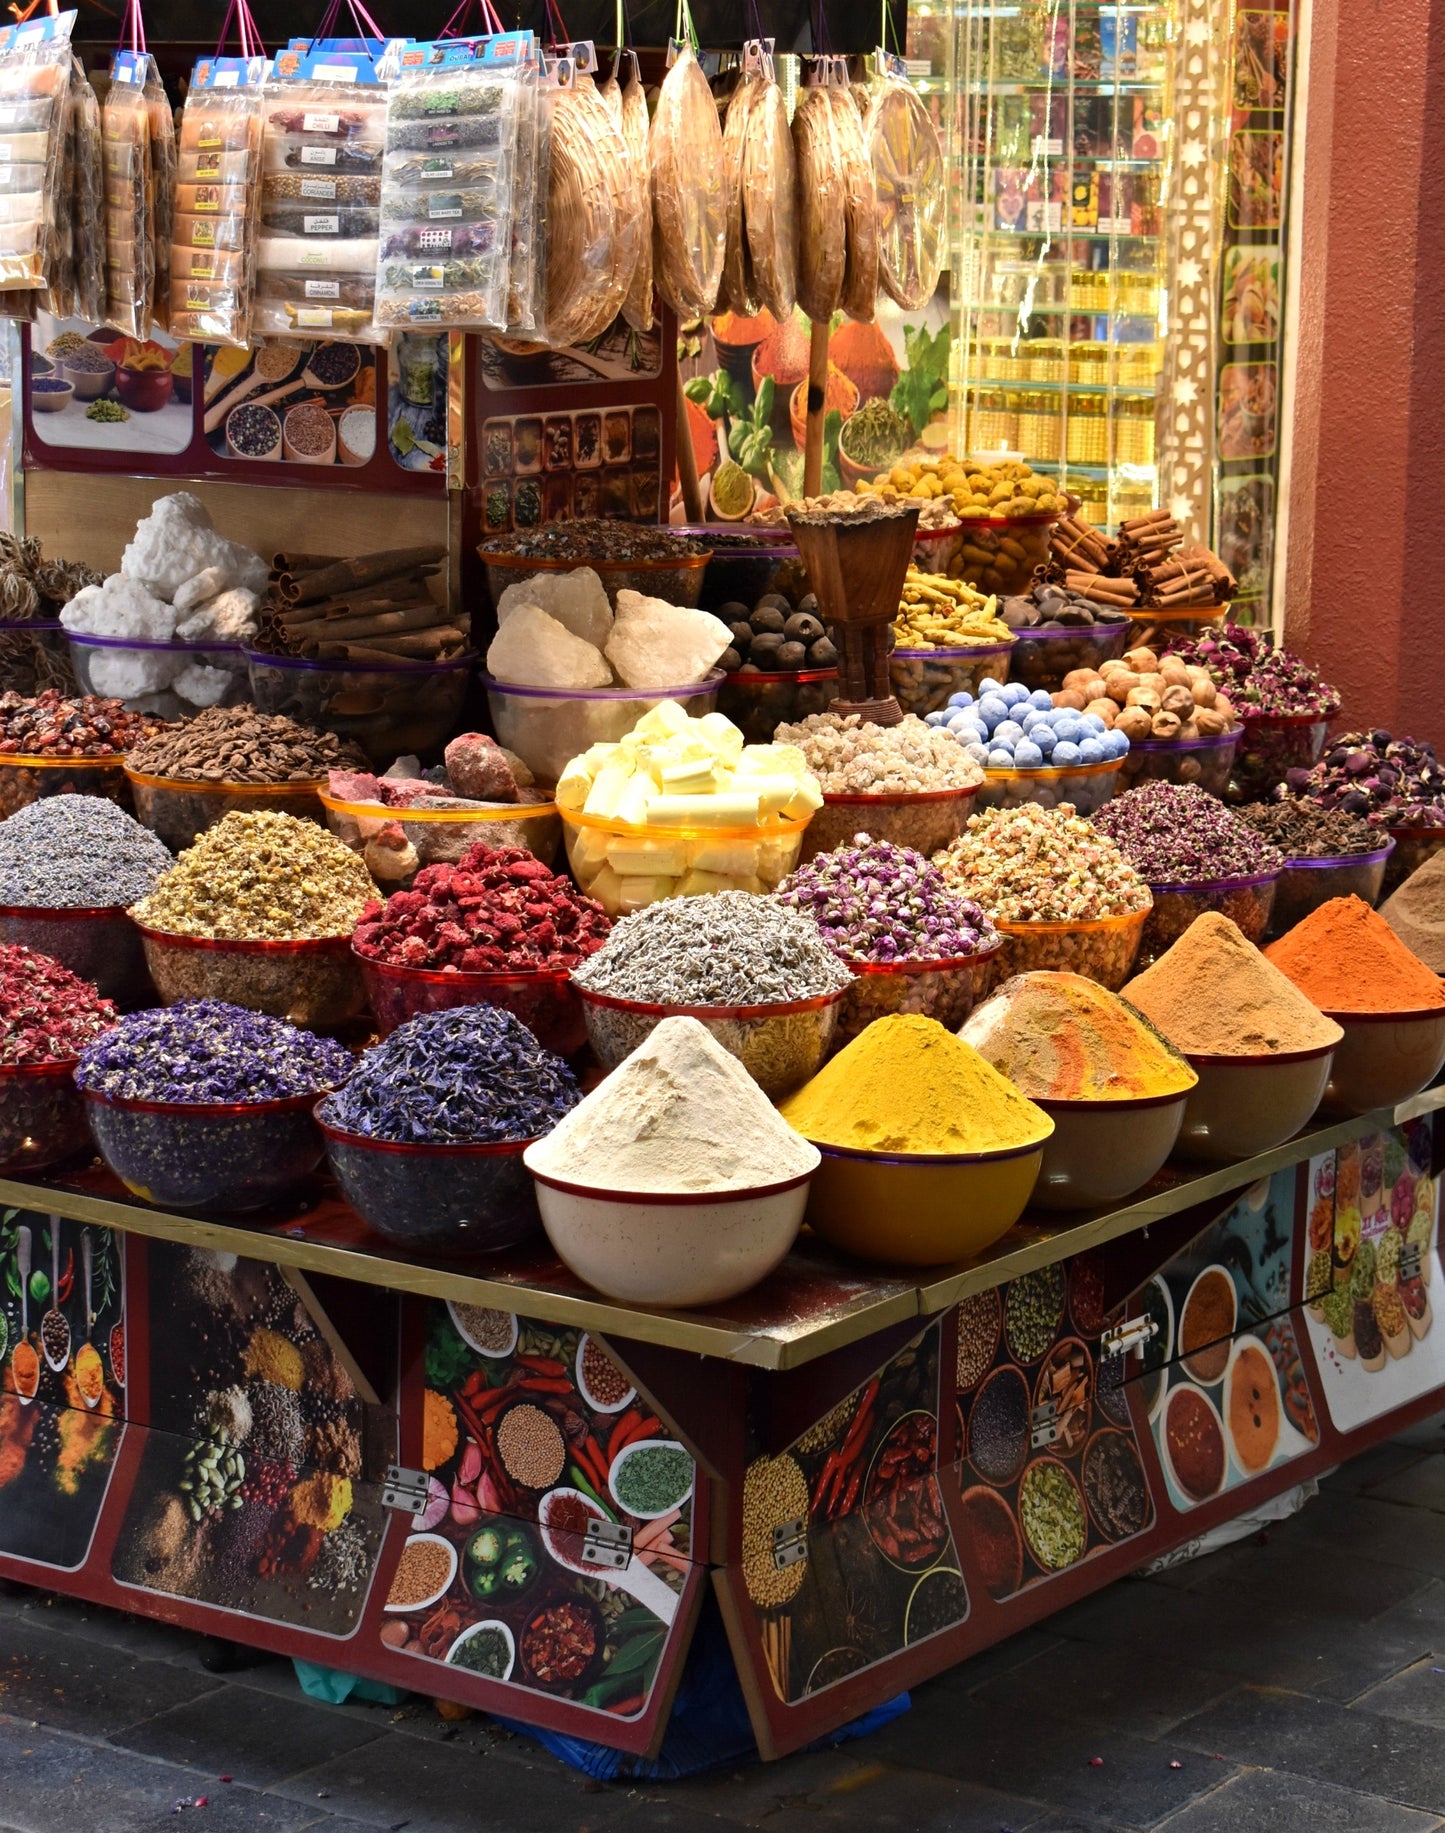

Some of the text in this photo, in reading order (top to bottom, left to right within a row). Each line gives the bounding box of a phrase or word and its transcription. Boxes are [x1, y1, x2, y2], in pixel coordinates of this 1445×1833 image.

[303, 188, 334, 197] CORIANDER
[301, 256, 328, 264] COCONUT
[310, 289, 335, 297] CINNAMON
